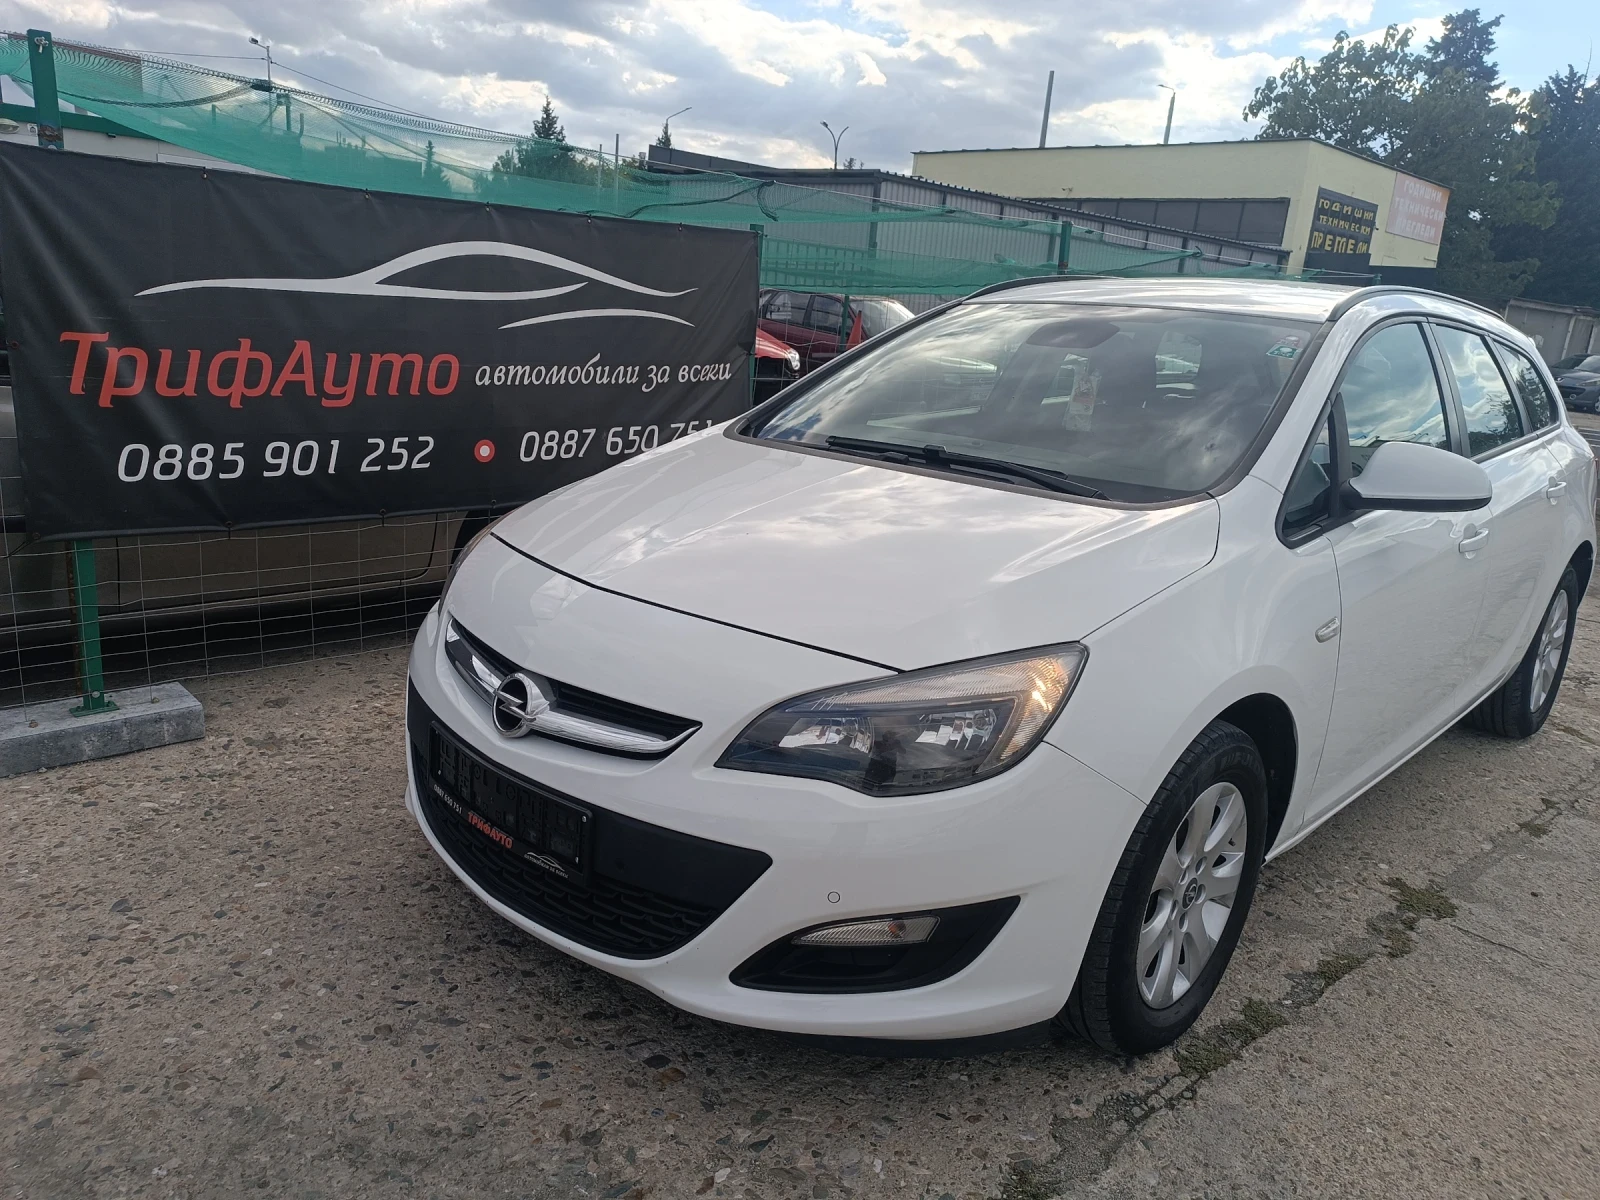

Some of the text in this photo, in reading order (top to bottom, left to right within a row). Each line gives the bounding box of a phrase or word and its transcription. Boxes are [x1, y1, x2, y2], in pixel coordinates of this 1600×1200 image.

[1319, 199, 1374, 220] ГОДИШНИ
[1394, 197, 1444, 222] ТЕХНИЧЕСКИ
[1403, 180, 1442, 203] ГОДИШНИ
[1319, 215, 1371, 235] ТЕХНИЧЕСКИ
[60, 331, 460, 409] ТрифАуто
[475, 353, 732, 393] автомобили за всеки
[117, 436, 435, 482] 0885 901 252
[519, 428, 597, 462] 0887
[606, 425, 659, 455] 650
[468, 811, 512, 849] ТРИФАУТО
